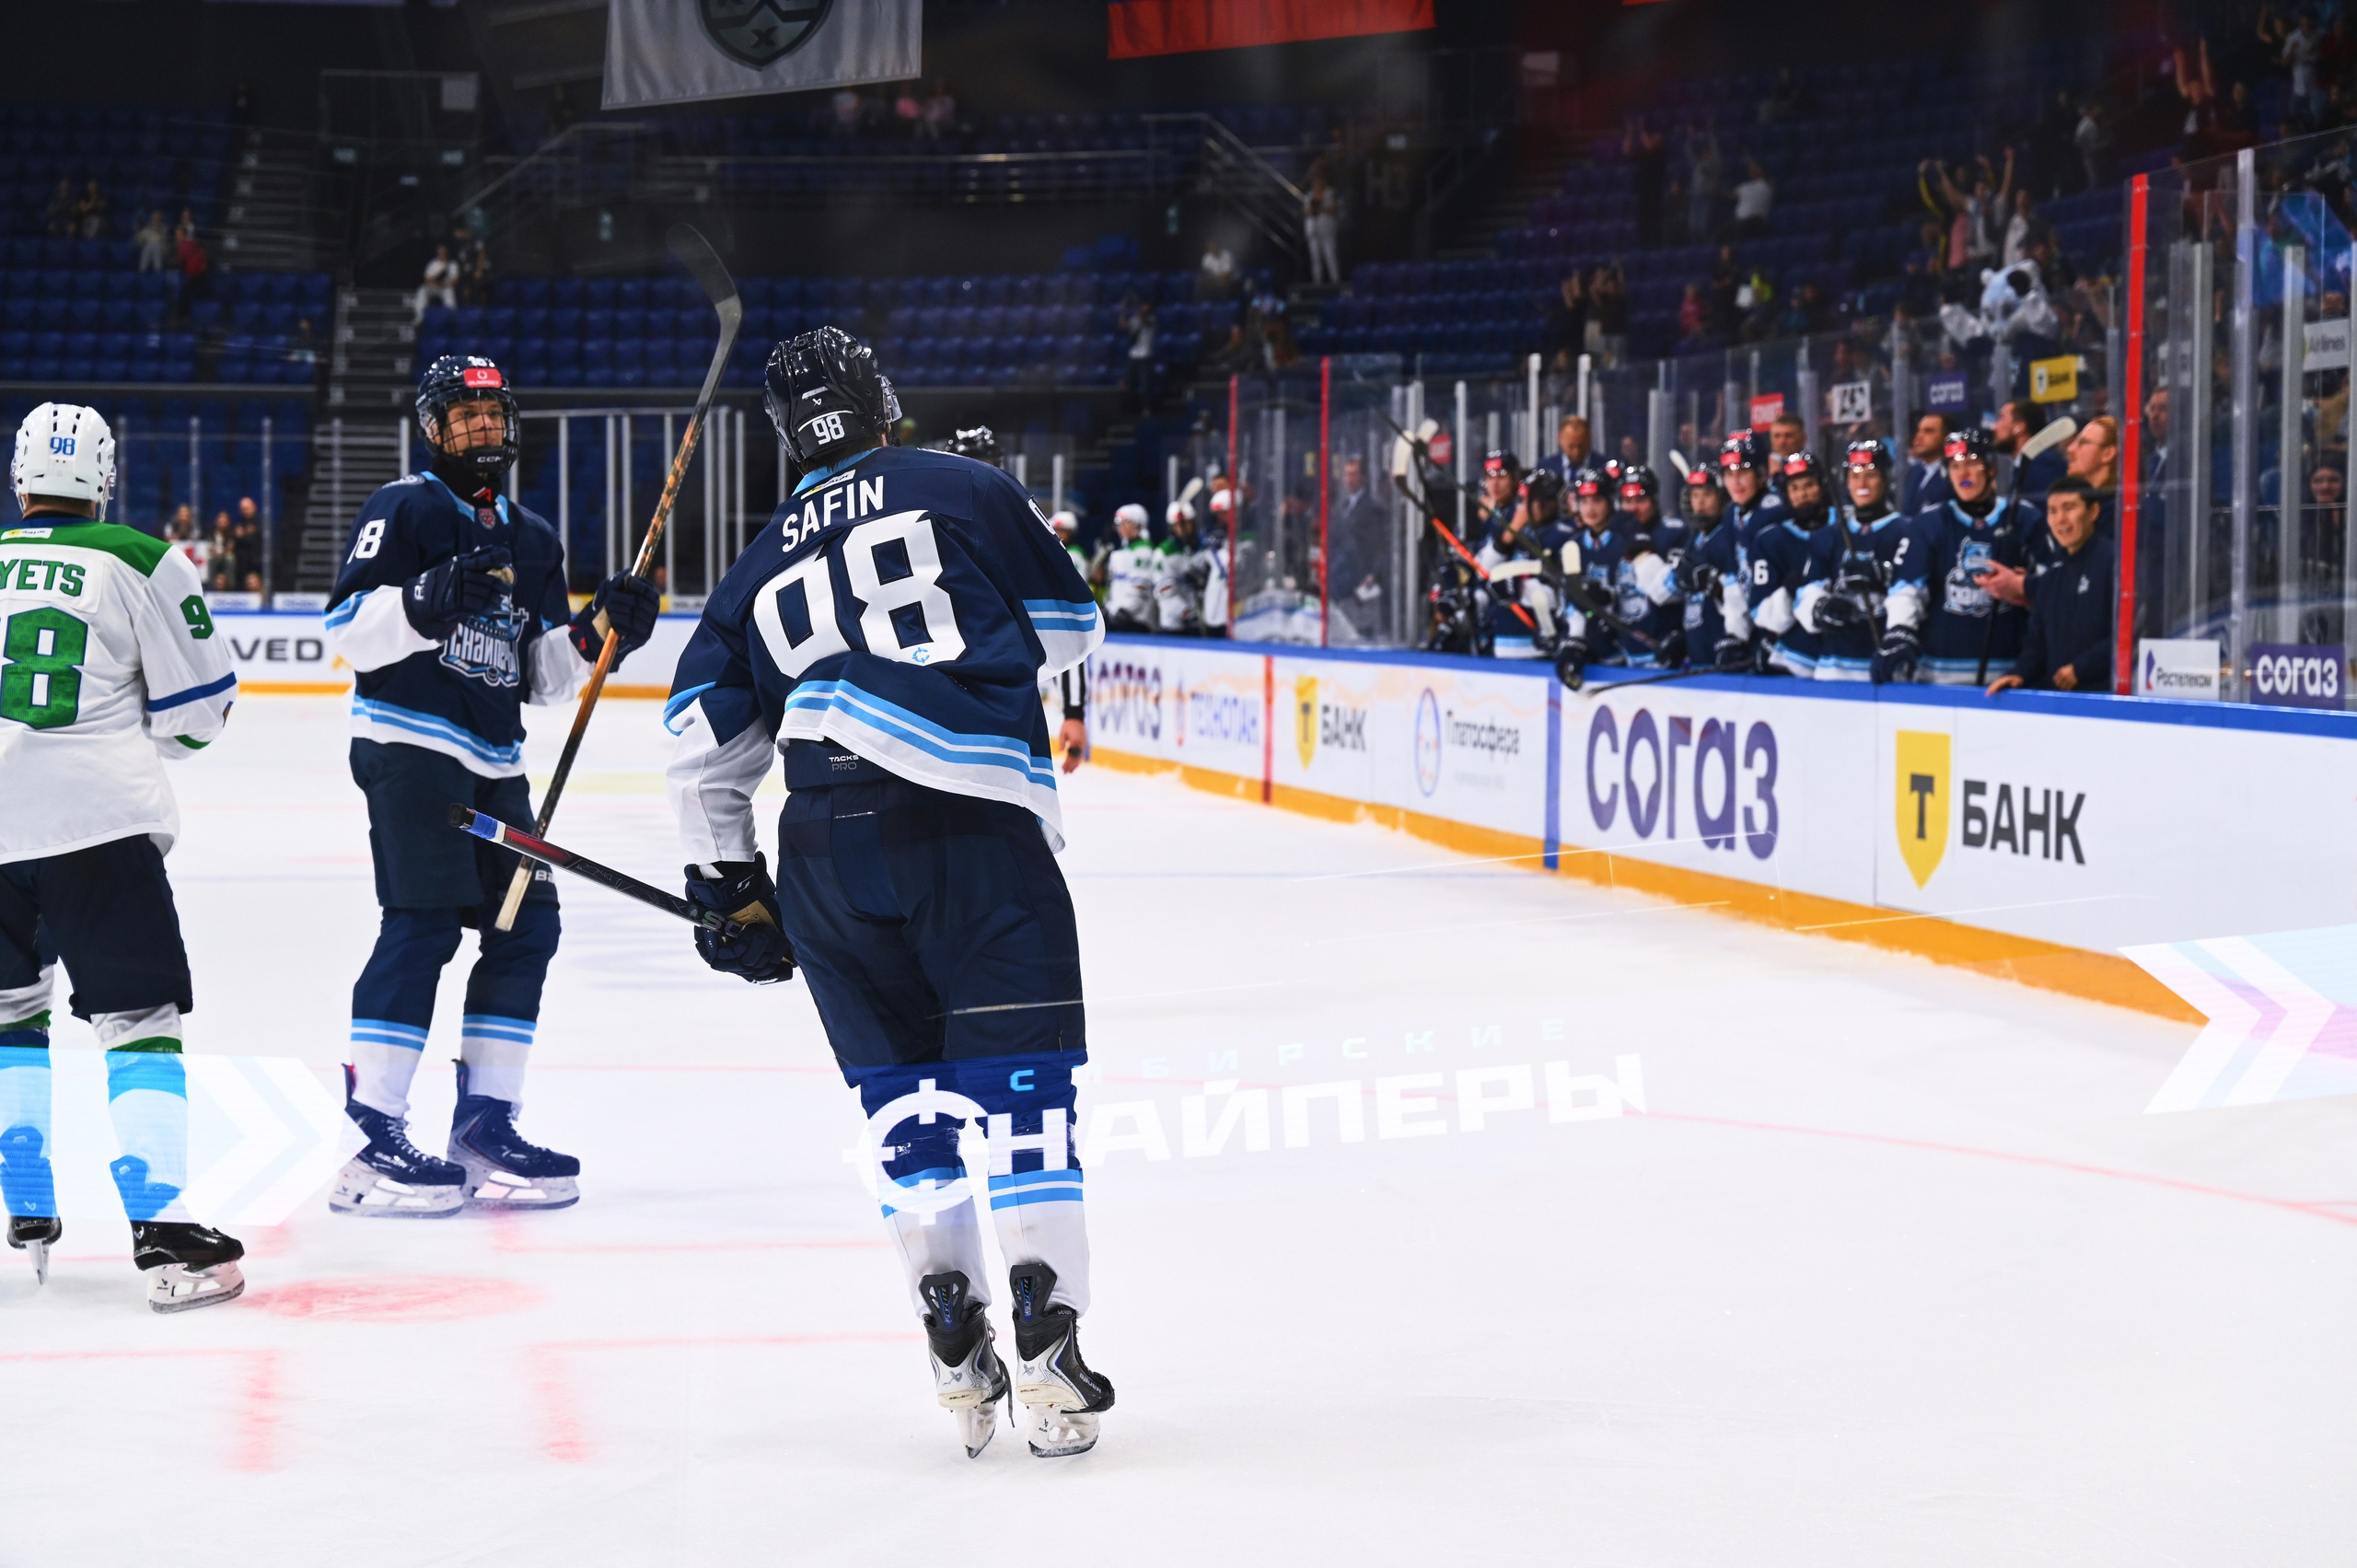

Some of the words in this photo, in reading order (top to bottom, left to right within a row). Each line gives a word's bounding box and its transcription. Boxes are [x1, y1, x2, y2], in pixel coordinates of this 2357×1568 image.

[50, 436, 75, 456] 98
[811, 413, 845, 446] 98
[782, 476, 884, 553] SAFIN
[753, 509, 967, 679] 98
[1321, 703, 1367, 752] БАНК
[831, 762, 857, 772] PRO
[1962, 778, 2086, 865] БАНК
